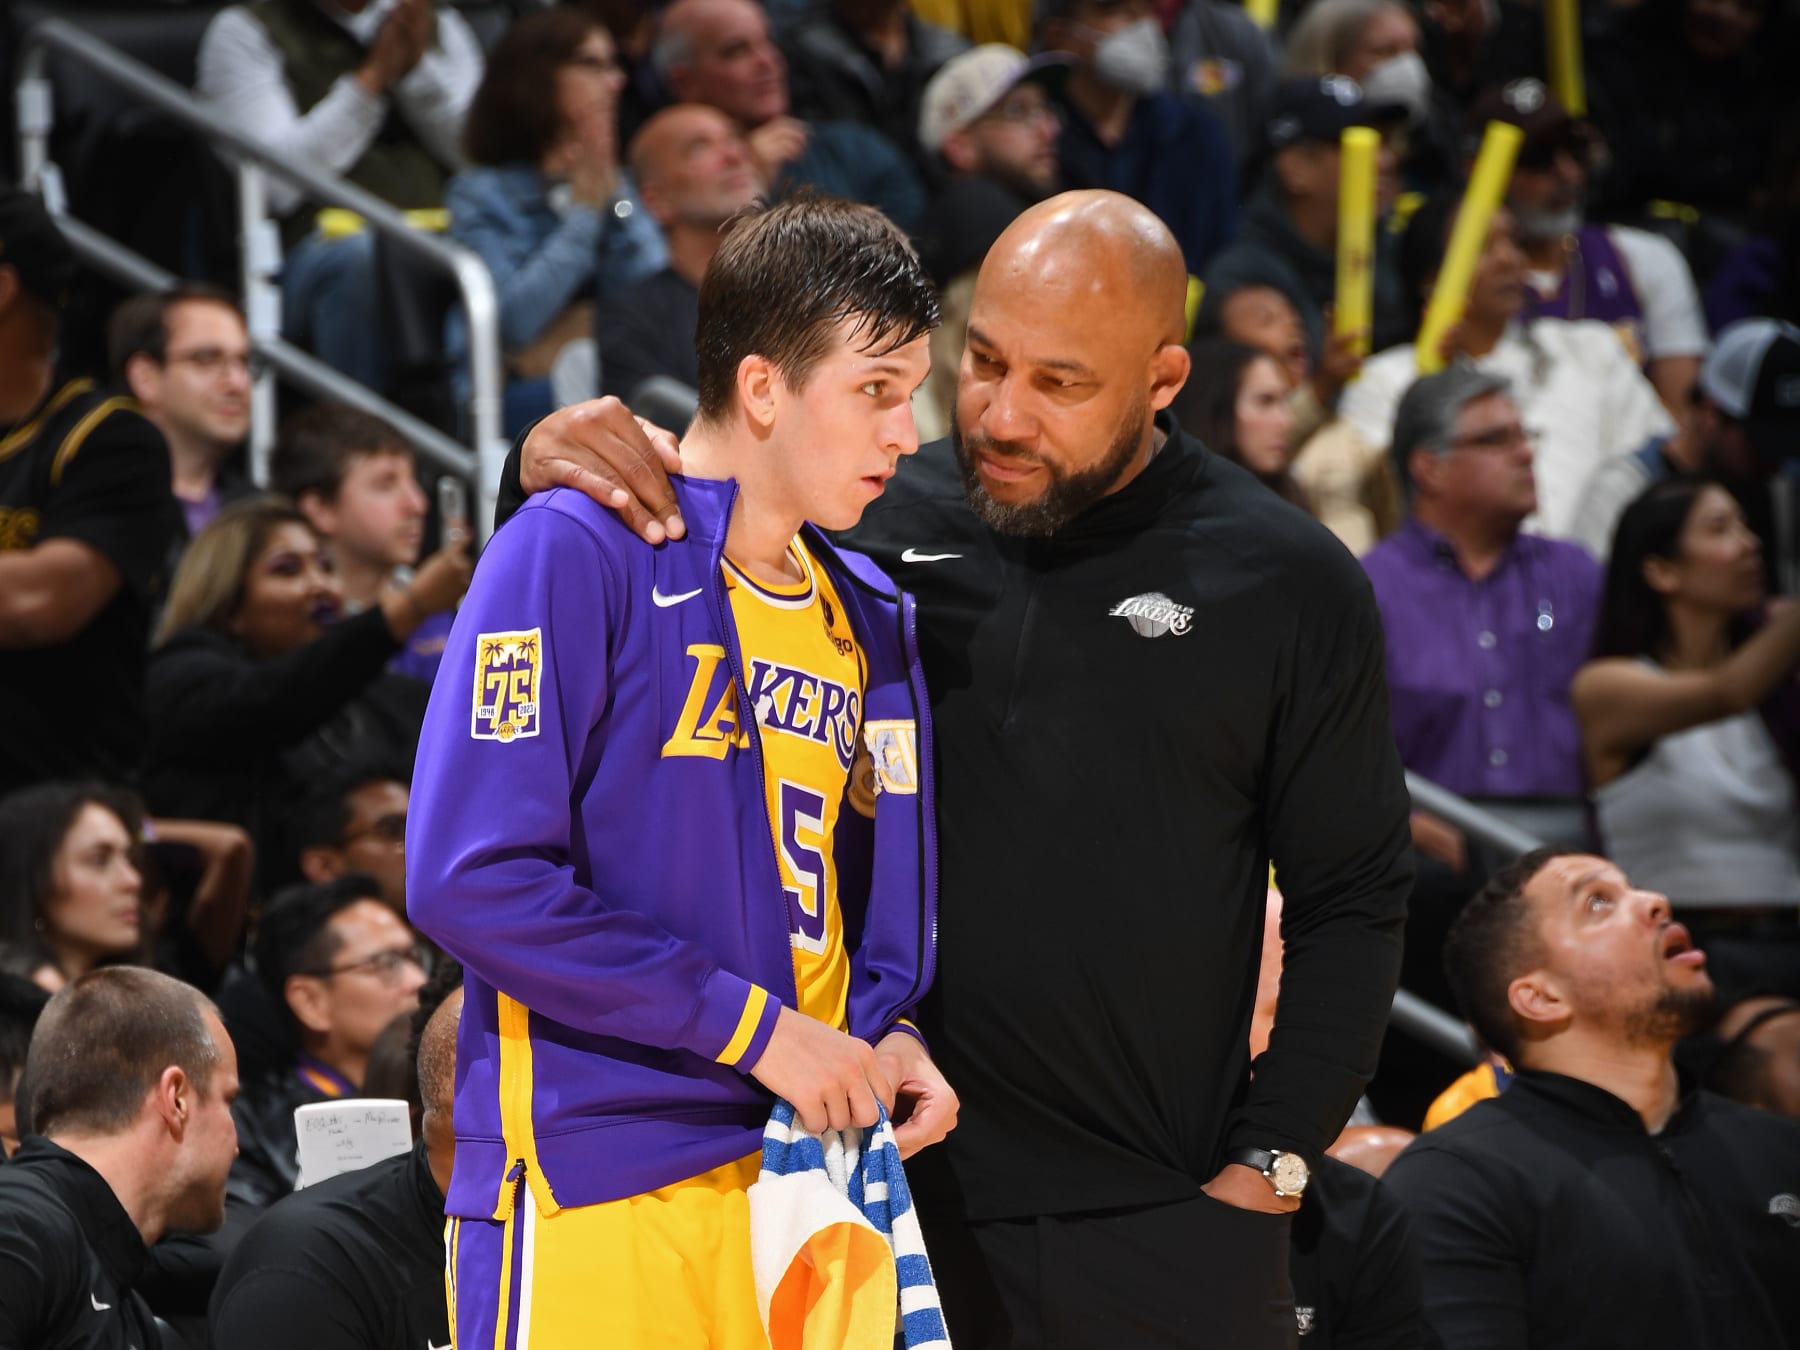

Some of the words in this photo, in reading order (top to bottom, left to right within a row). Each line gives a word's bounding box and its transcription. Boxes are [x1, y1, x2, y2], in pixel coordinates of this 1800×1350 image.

[1107, 597, 1193, 636] LAKERS
[486, 669, 531, 730] 75
[519, 704, 534, 715] 2023
